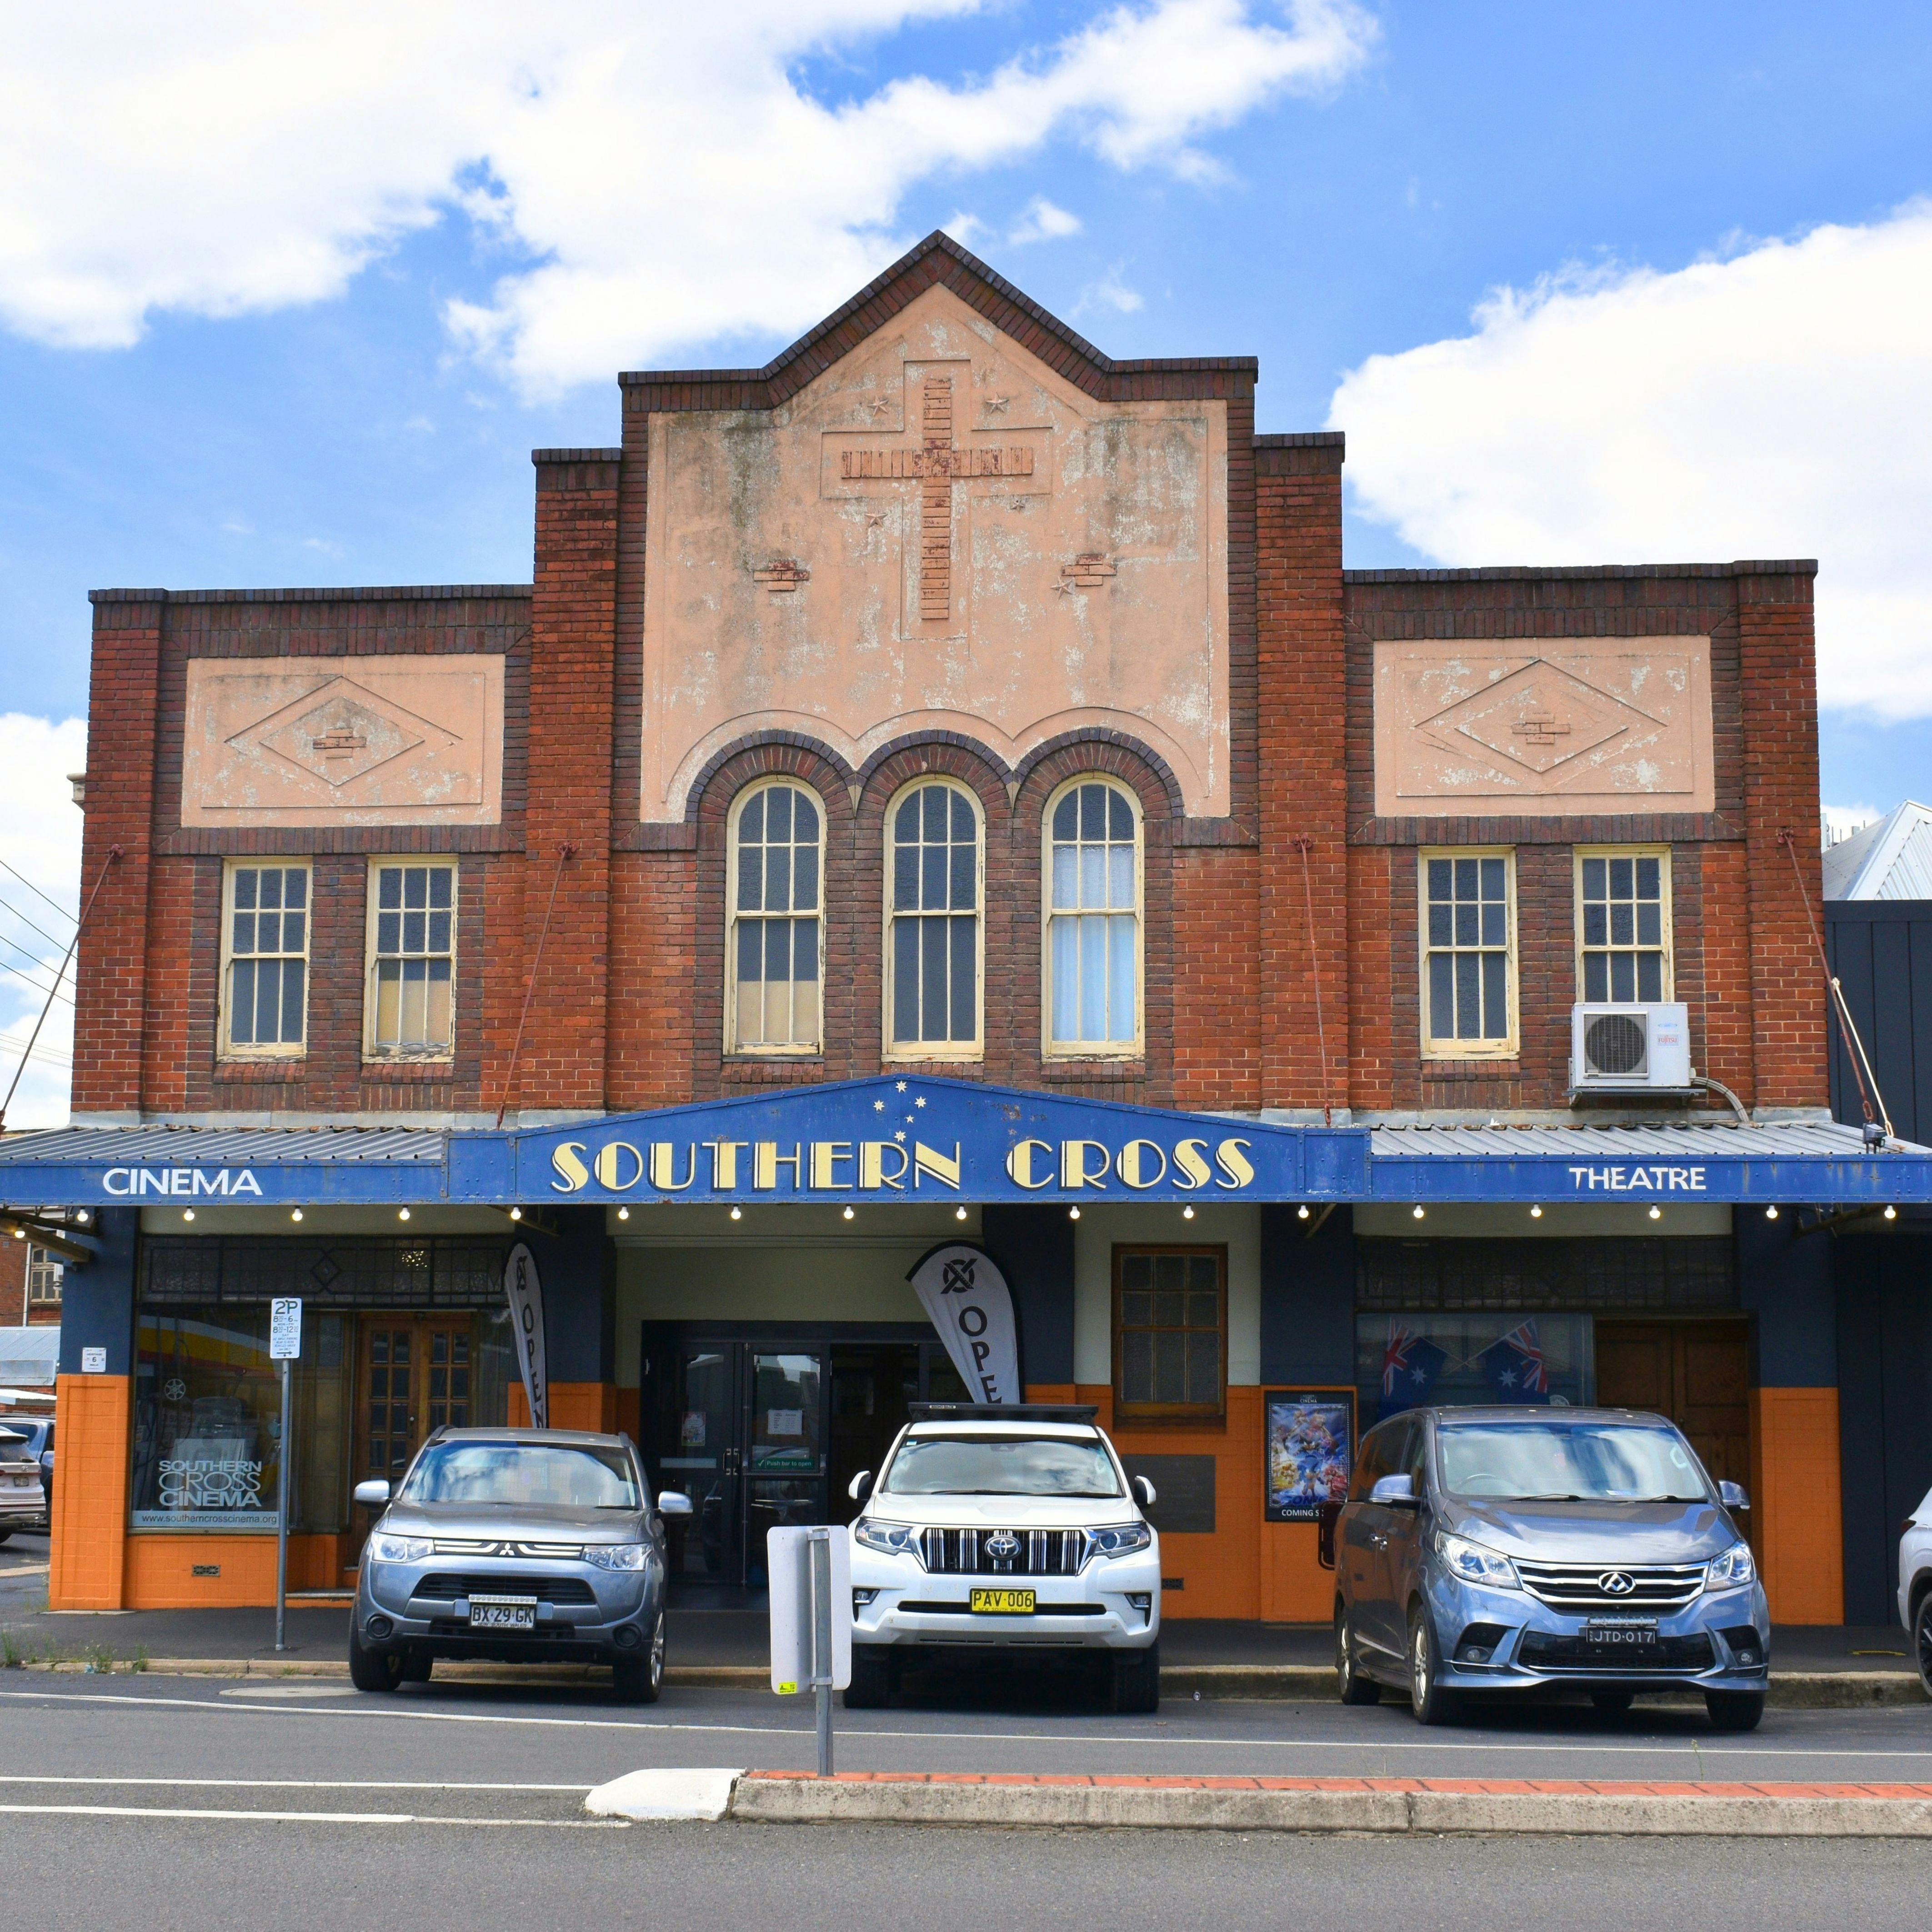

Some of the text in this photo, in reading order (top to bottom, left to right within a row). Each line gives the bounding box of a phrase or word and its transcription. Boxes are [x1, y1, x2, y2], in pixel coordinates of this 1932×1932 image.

[551, 1138, 1256, 1193] SOUTHERN CROSS
[103, 1168, 263, 1196] CINEMA
[1569, 1167, 1706, 1190] THEATRE
[275, 1301, 298, 1314] 2P
[522, 1303, 544, 1428] OPEN
[959, 1306, 1002, 1404] OPE
[159, 1460, 262, 1472] SOUTHERN
[159, 1471, 261, 1491] CROSS
[160, 1491, 262, 1507] CINEMA
[142, 1513, 277, 1524] www.southerncrosscinema.org
